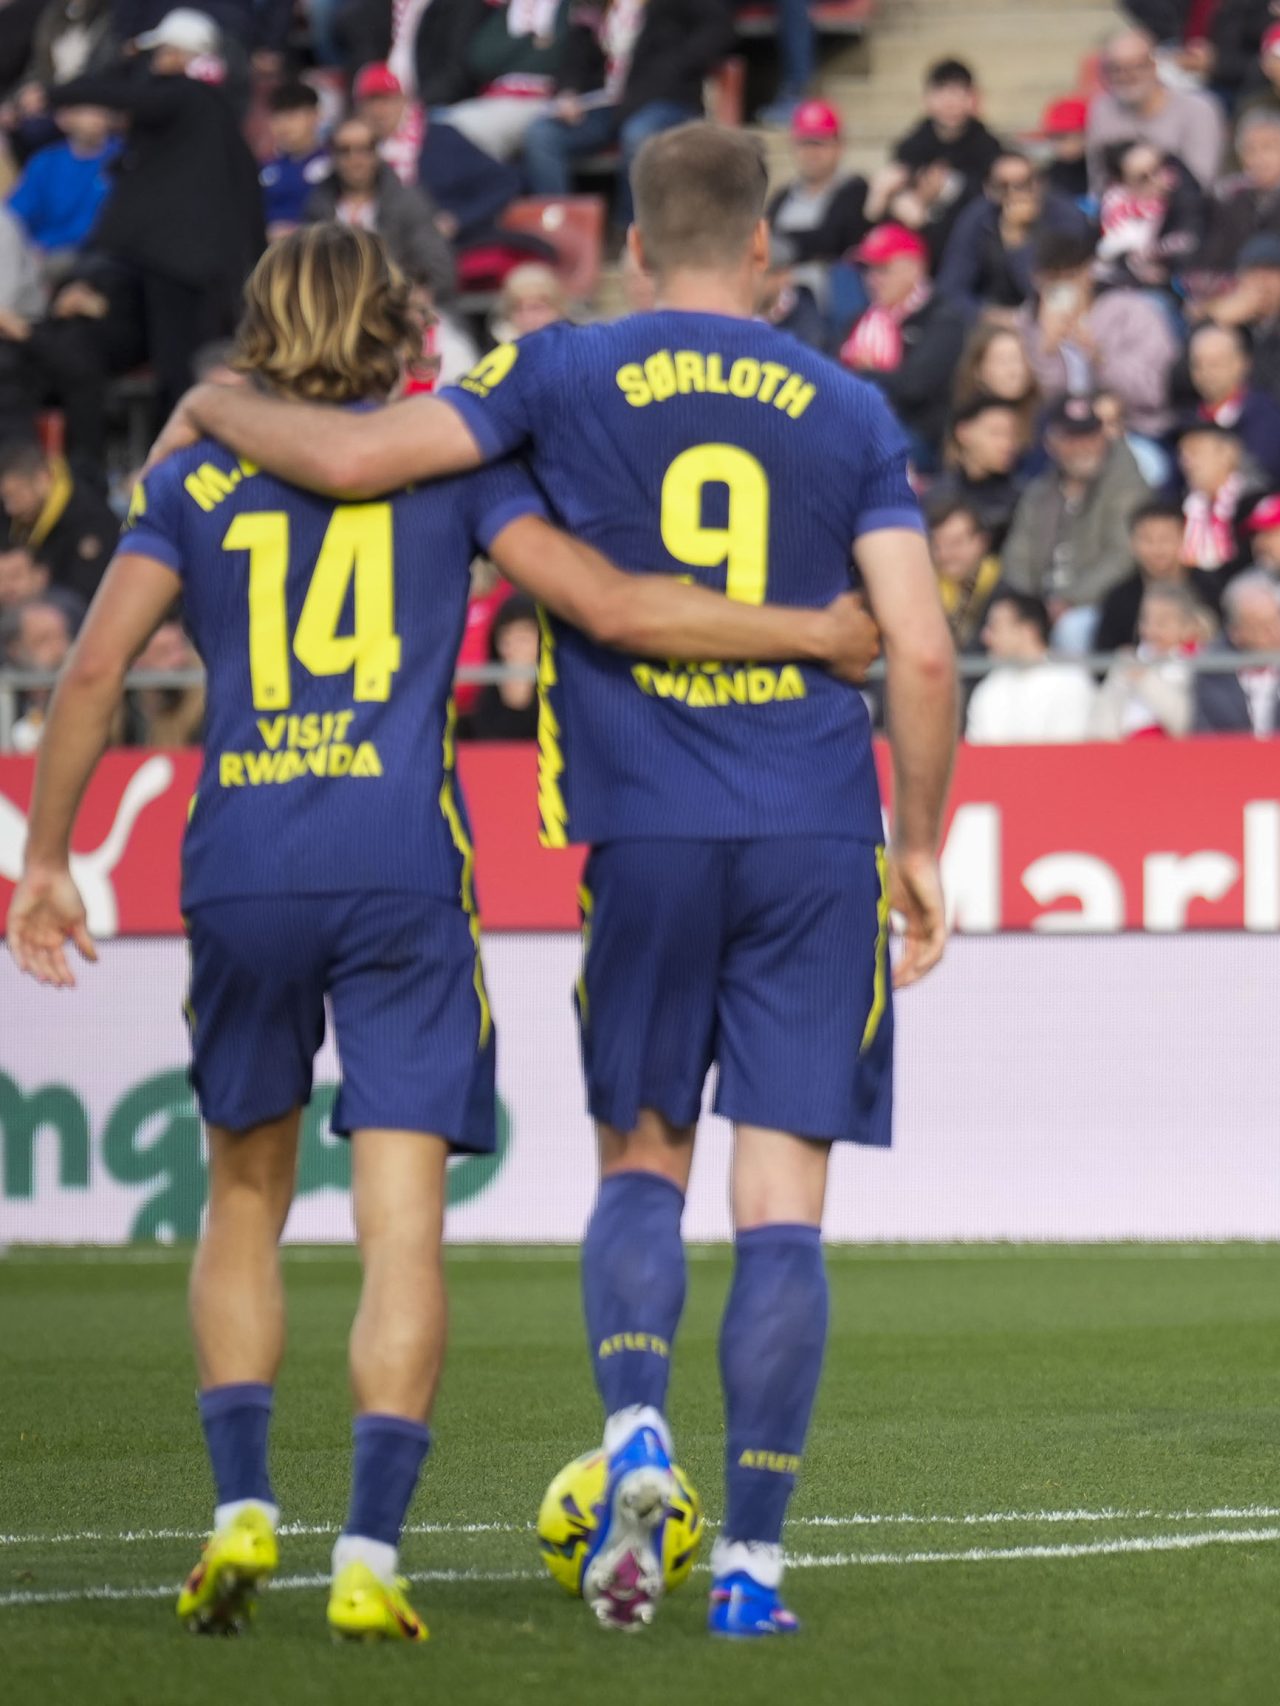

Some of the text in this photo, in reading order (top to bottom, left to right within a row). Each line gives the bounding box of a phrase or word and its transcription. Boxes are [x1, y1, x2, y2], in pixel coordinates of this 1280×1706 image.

[615, 350, 816, 419] SØRLOTH
[661, 442, 770, 607] 9
[222, 501, 401, 710] 14
[256, 708, 355, 750] VISIT
[219, 740, 383, 788] RWANDA
